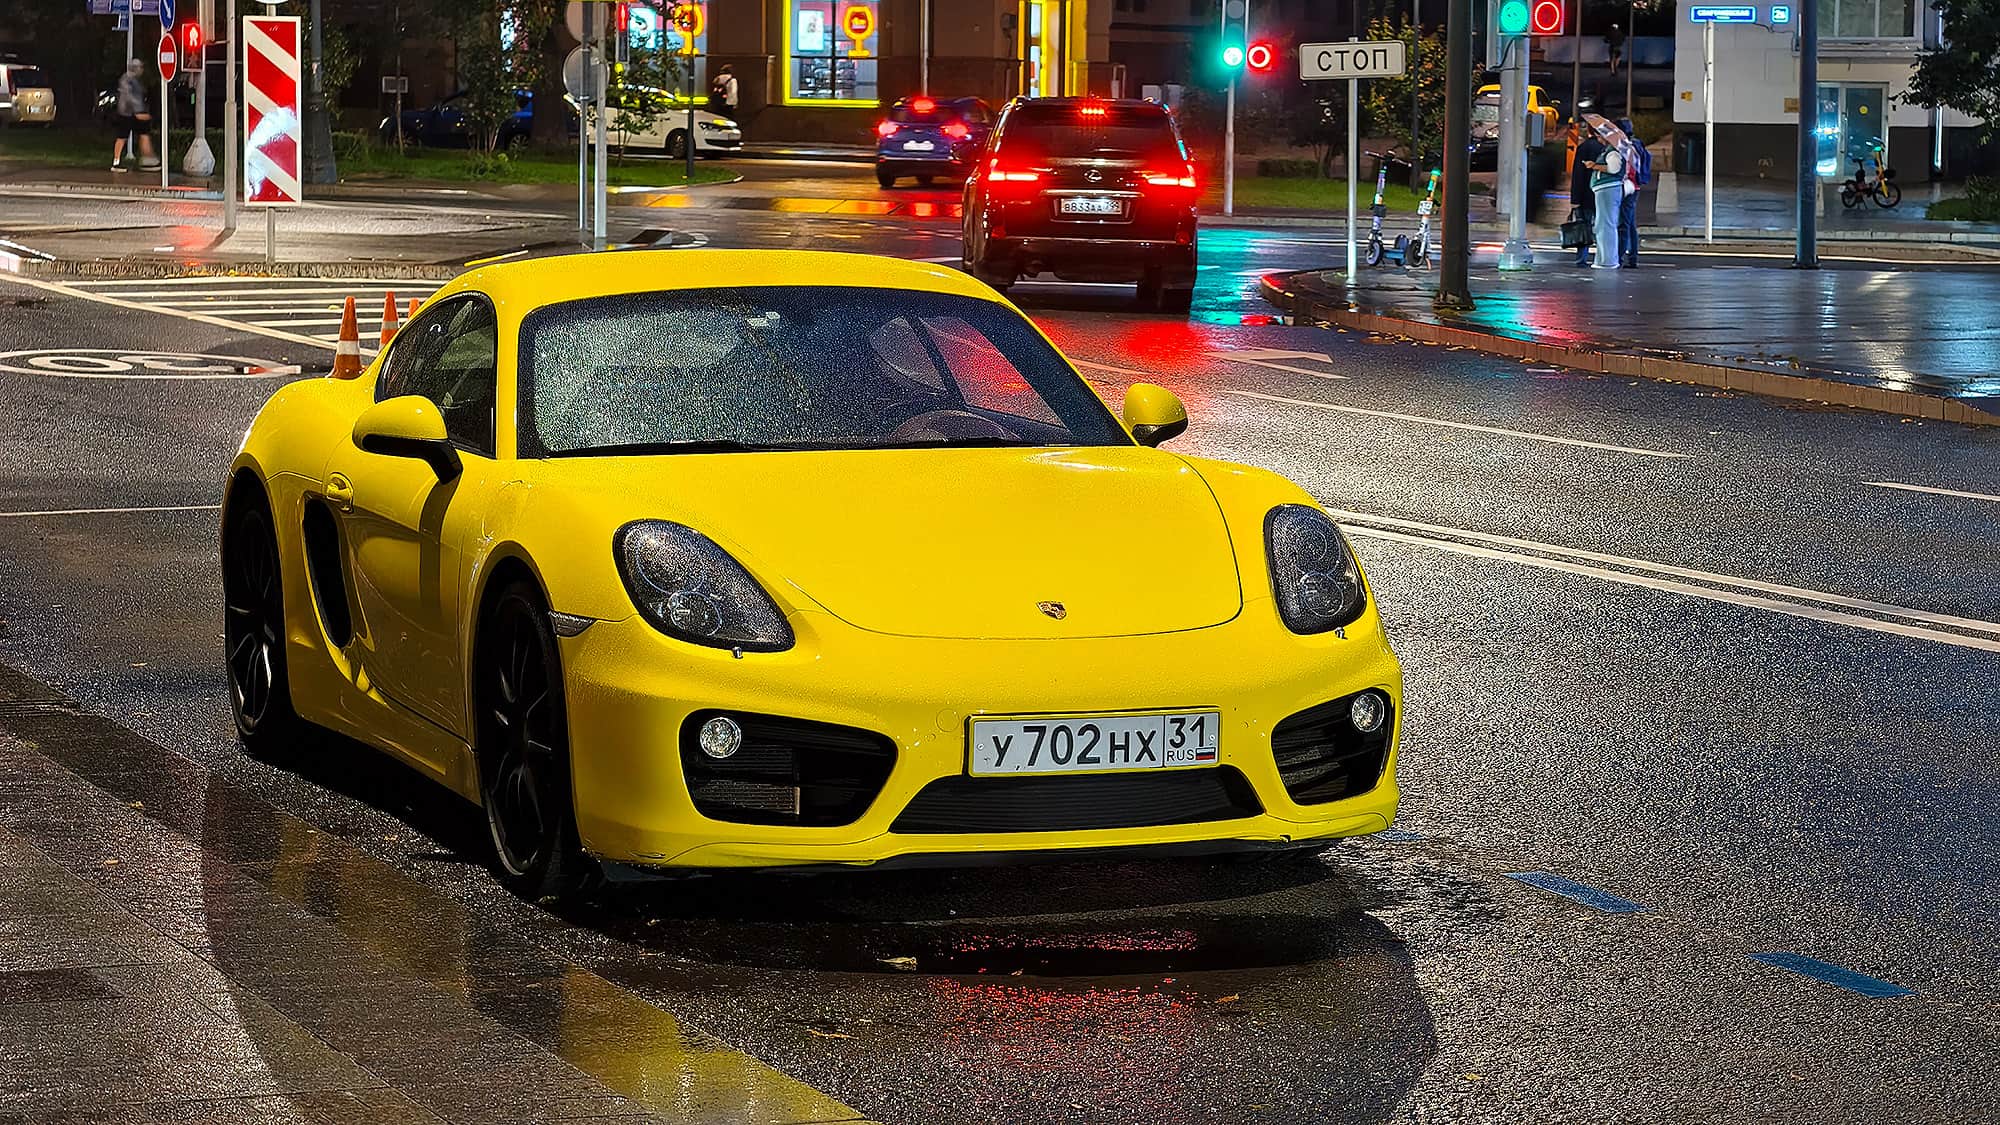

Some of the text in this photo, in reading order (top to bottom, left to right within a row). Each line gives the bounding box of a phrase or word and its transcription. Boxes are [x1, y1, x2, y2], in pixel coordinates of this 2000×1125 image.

[1317, 48, 1388, 72] СТОП
[991, 716, 1207, 767] У702НХ 31
[1166, 748, 1195, 762] RUS
